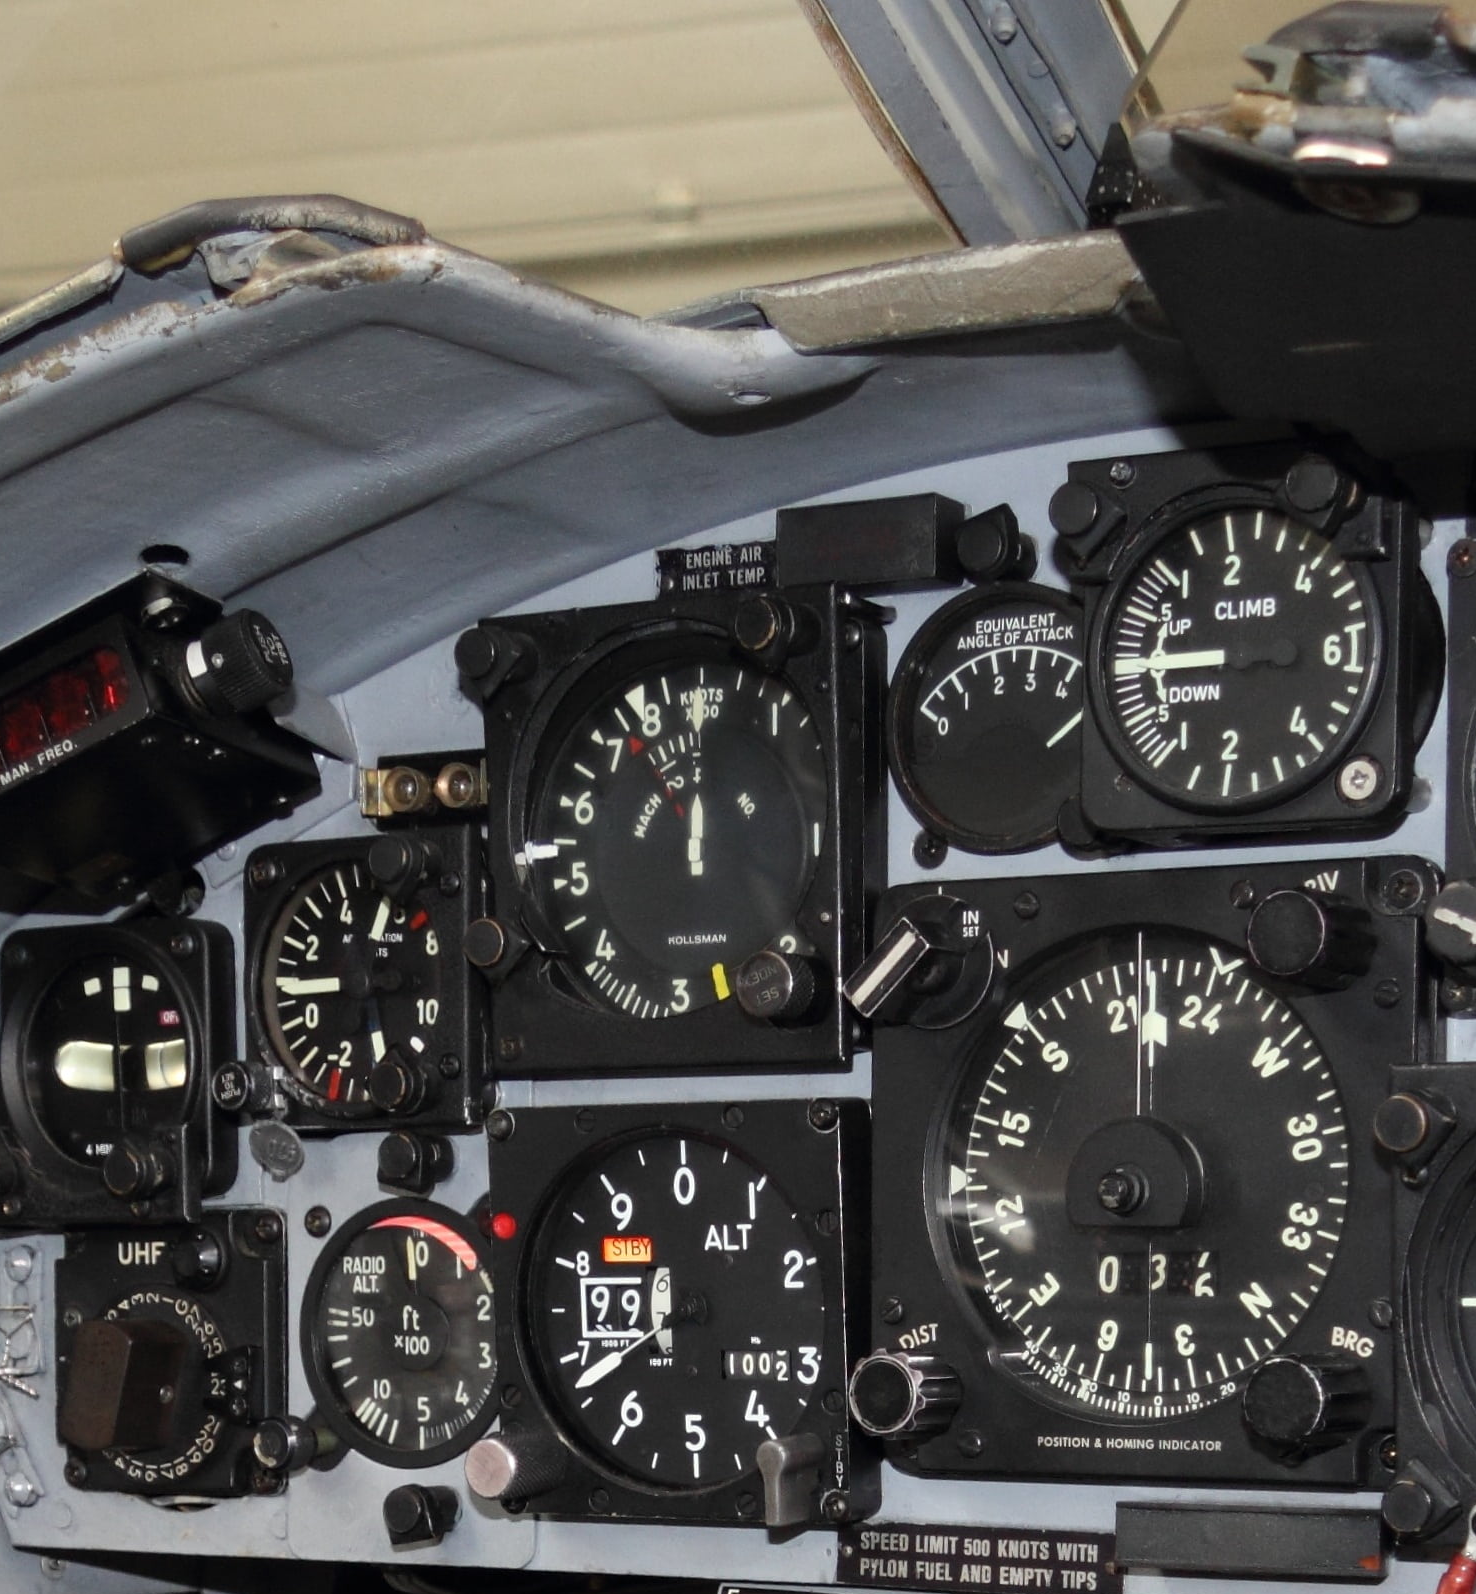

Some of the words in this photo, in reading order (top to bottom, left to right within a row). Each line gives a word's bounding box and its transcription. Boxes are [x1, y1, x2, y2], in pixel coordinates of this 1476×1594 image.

[686, 549, 733, 569] ENGINE
[739, 546, 763, 563] AIR
[1214, 599, 1276, 620] CLIMB
[975, 614, 1055, 634] EQUIVALENT
[957, 634, 1000, 651] ANGLE
[1003, 632, 1020, 645] OF
[1024, 626, 1073, 643] ATTACK
[1169, 685, 1220, 702] DOWN
[37, 740, 78, 771] FREQ.
[669, 933, 727, 945] KOLLSMAN
[612, 1238, 652, 1256] STBY
[705, 1225, 752, 1251] ALT
[118, 1241, 166, 1265] UHF
[343, 1256, 386, 1275] RADIO
[1331, 1328, 1373, 1358] BRG
[1037, 1436, 1090, 1449] POSITION
[1105, 1438, 1155, 1450] HOMING
[1159, 1440, 1222, 1452] INDICATOR
[835, 1434, 843, 1487] STBY
[860, 1532, 909, 1552] SPEED
[916, 1535, 957, 1556] LIMIT
[964, 1538, 991, 1557] 500
[997, 1540, 1050, 1561] KNOTS
[1057, 1543, 1098, 1563] WITH
[860, 1558, 908, 1579] PYLON
[915, 1561, 954, 1581] FUEL
[959, 1564, 992, 1583] AND
[999, 1566, 1051, 1589] EMPTY
[1060, 1570, 1097, 1590] TIPS
